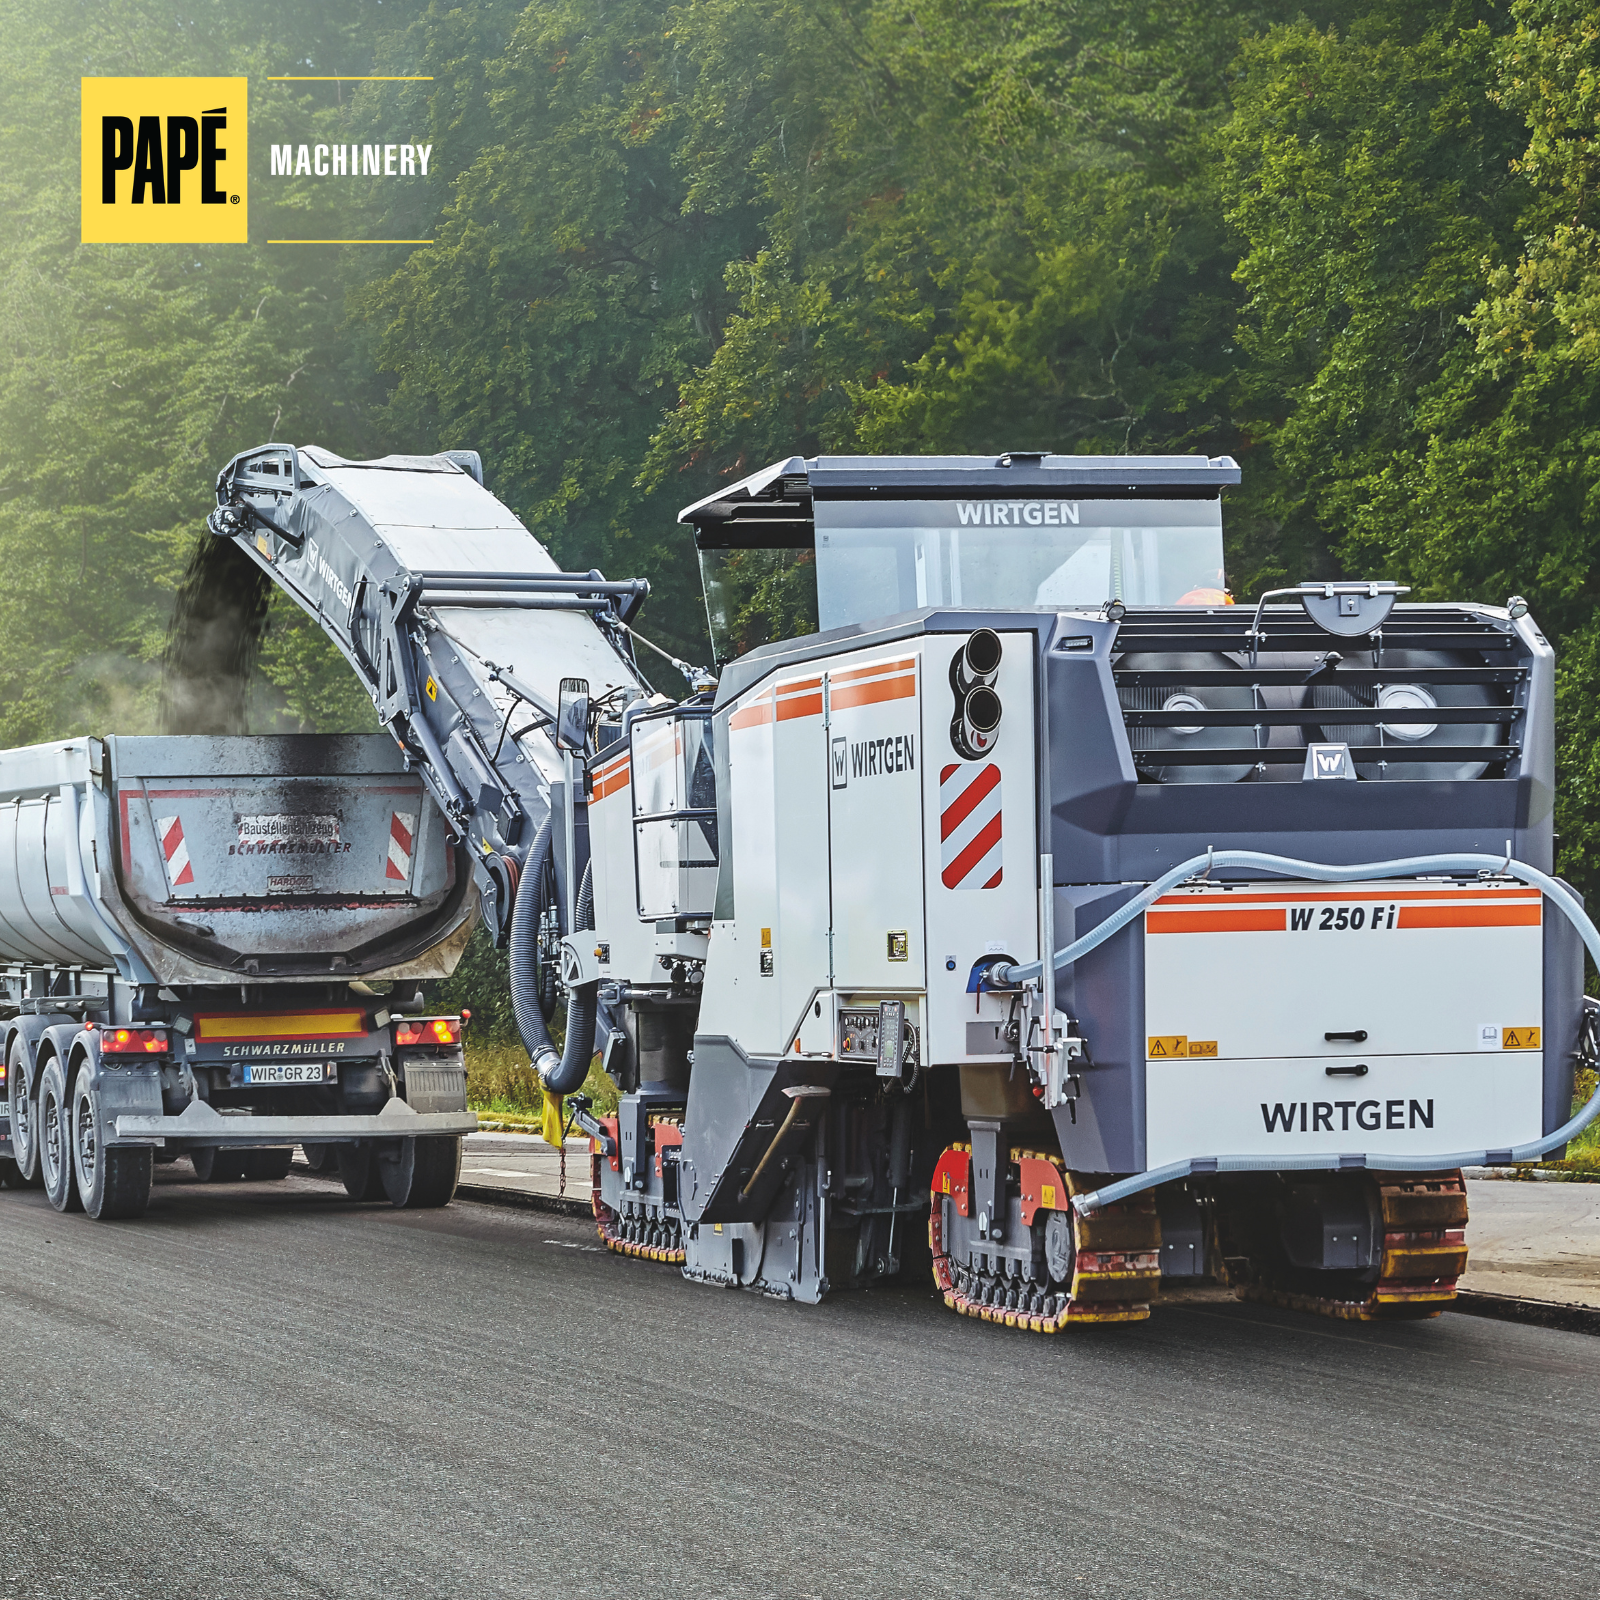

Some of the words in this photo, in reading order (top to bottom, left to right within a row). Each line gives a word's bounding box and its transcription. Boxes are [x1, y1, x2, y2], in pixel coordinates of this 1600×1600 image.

[956, 503, 1080, 525] WIRTGEN
[851, 734, 915, 778] WIRTGEN
[1317, 753, 1342, 772] W
[1291, 908, 1315, 931] W
[1319, 907, 1365, 931] 250
[1371, 904, 1396, 930] Fi
[223, 1042, 345, 1057] SCHWARZMÜLLER
[251, 1068, 277, 1081] WIR
[284, 1067, 303, 1080] GR
[306, 1066, 321, 1080] 23
[1260, 1099, 1434, 1133] WIRTGEN
